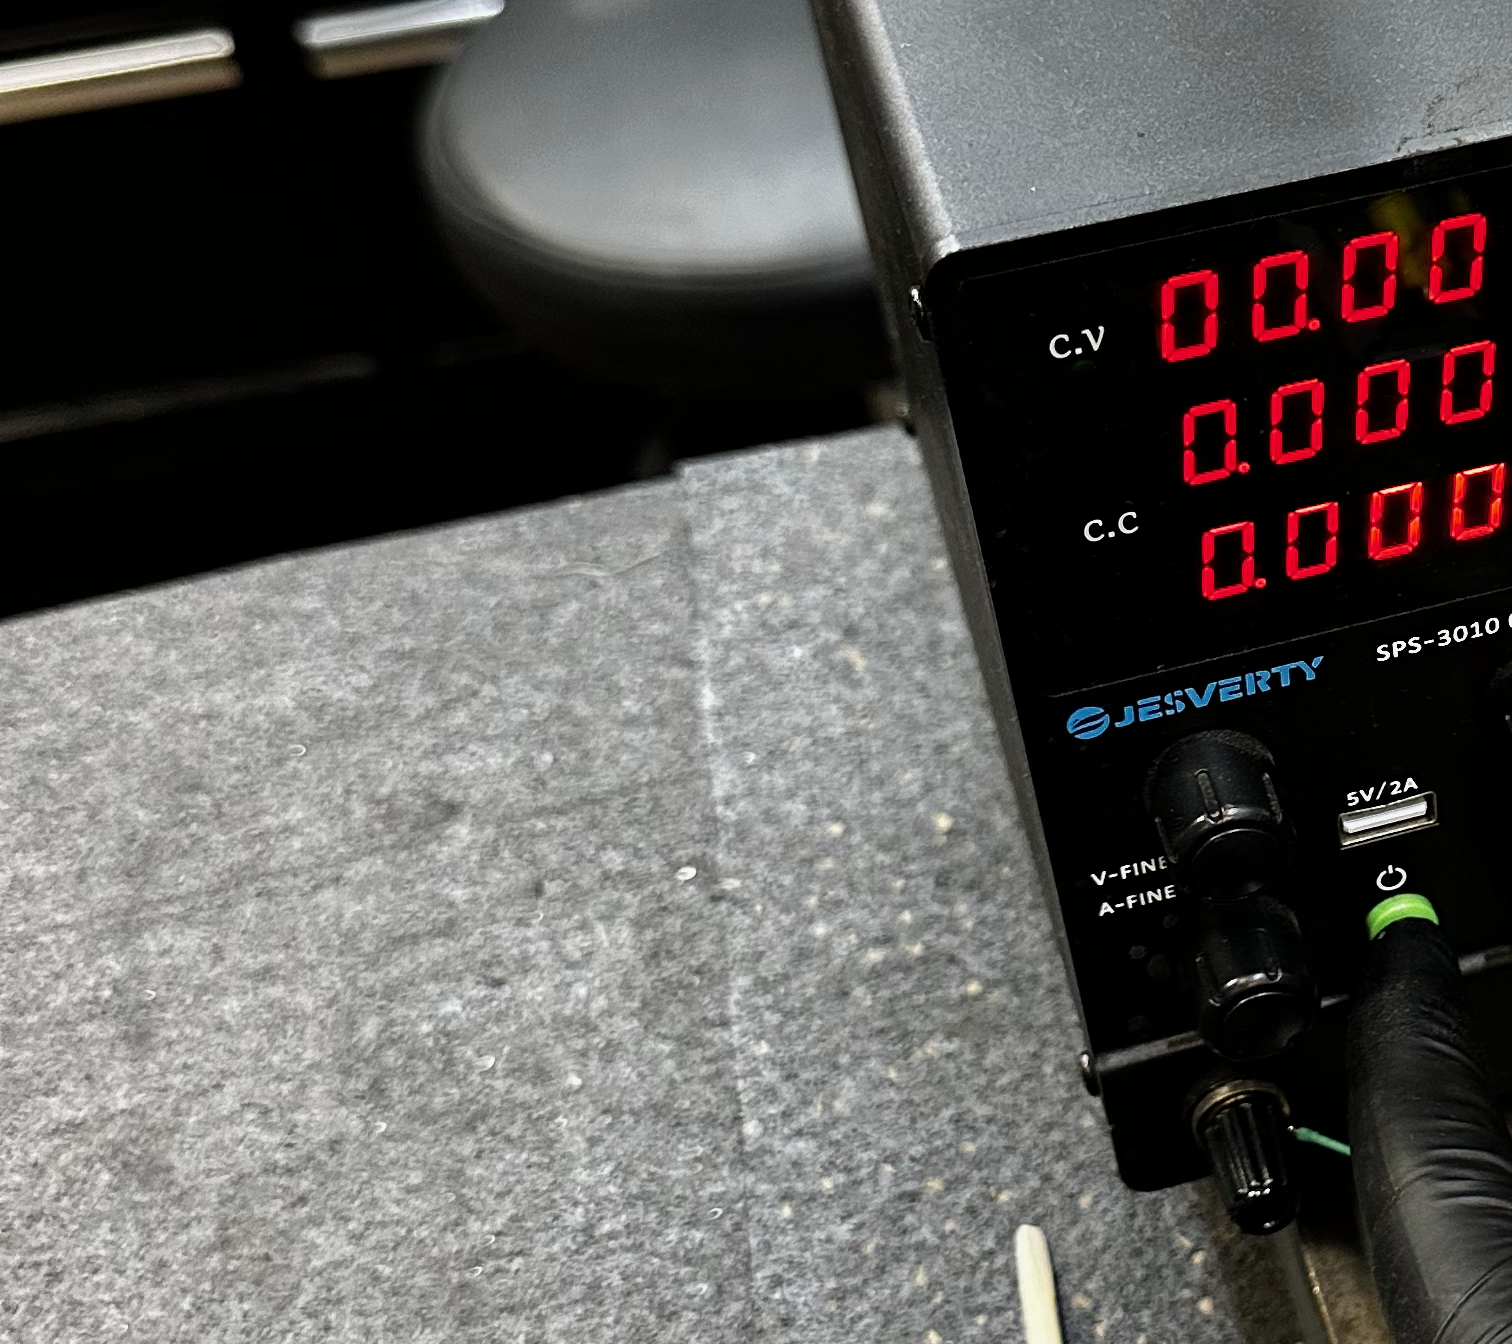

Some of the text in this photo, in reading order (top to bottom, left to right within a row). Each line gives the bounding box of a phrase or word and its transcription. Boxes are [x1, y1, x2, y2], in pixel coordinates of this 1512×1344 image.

[1160, 212, 1487, 362] 00.00
[1183, 340, 1496, 485] 0.000
[1201, 463, 1506, 600] 0.000
[1376, 617, 1500, 662] SPS-3010
[1114, 655, 1325, 729] JESVERTY
[1346, 776, 1419, 807] 5V/2A
[1091, 856, 1167, 885] V-FINE
[1099, 885, 1176, 916] A-FINE
